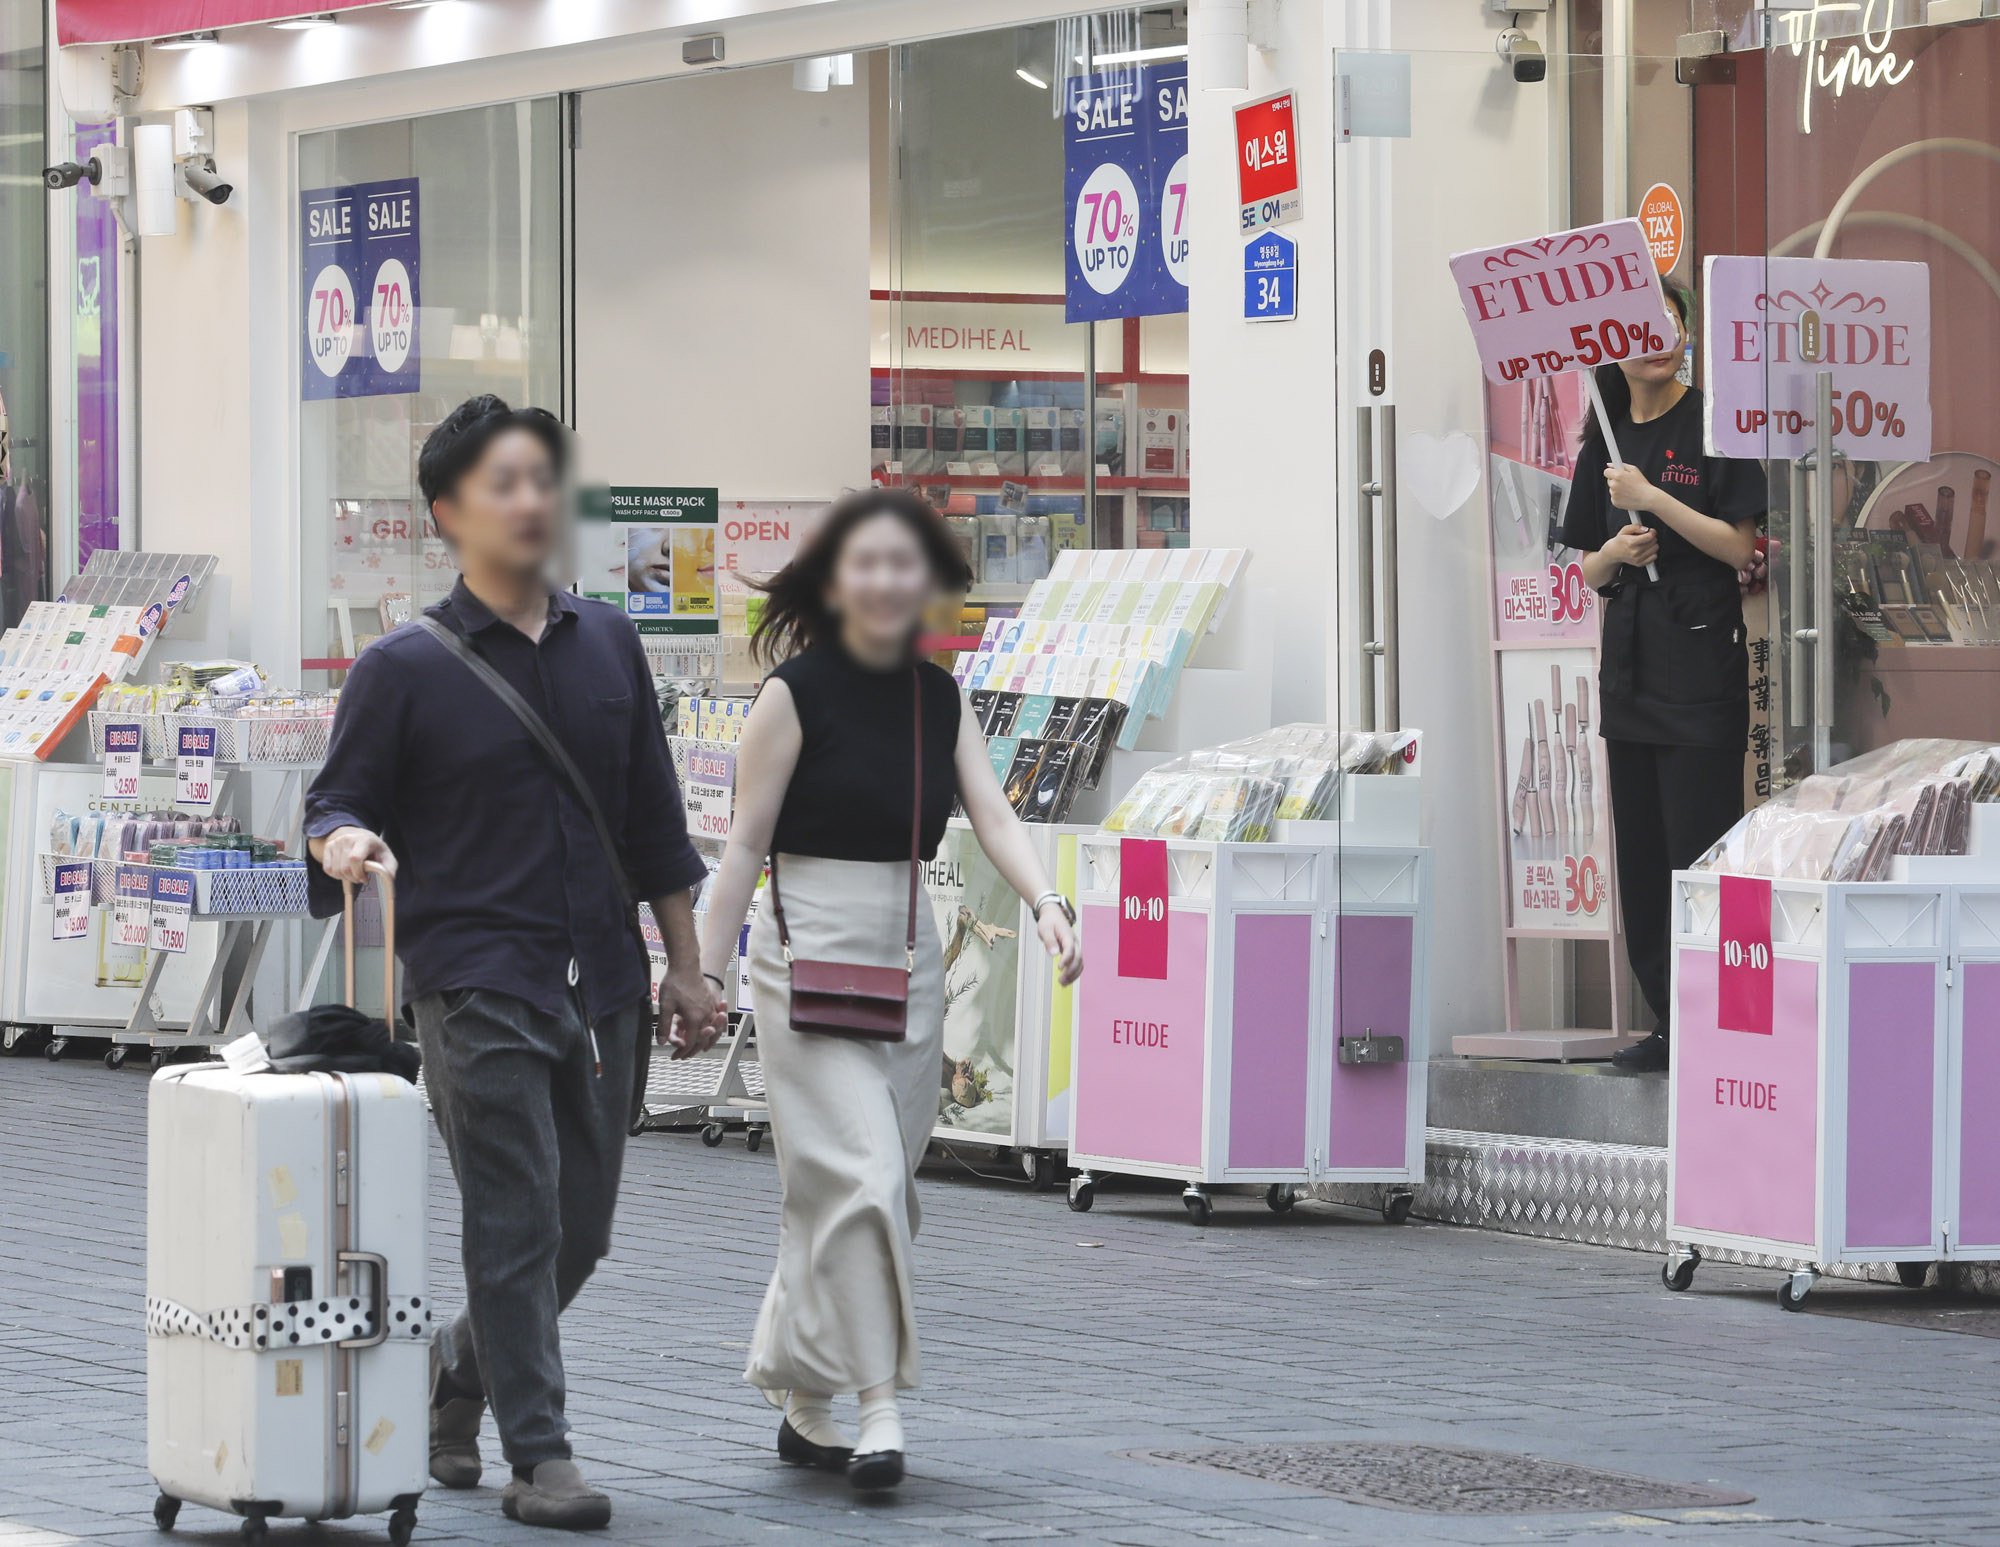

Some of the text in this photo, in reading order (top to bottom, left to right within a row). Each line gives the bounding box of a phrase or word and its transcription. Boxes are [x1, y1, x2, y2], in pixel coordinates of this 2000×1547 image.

[1076, 93, 1133, 132] SALE
[1245, 129, 1288, 171] 에스원
[368, 199, 411, 231] SALE
[1084, 190, 1134, 244] 70%
[1170, 183, 1188, 235] 7
[1242, 199, 1280, 229] SECOM
[1647, 201, 1675, 214] GLOBAL
[309, 206, 351, 238] SALE
[1646, 214, 1675, 239] TAX
[1085, 245, 1129, 272] UP TO
[1257, 276, 1280, 310] 34
[1468, 252, 1649, 322] ETUDE
[315, 287, 352, 334] 70%
[378, 282, 410, 329] 70%
[315, 336, 348, 358] UP TO
[378, 330, 407, 352] UP TO
[907, 326, 1031, 351] MEDIHEAL
[1731, 320, 1910, 366] ETUDE
[1498, 357, 1529, 381] UP
[1736, 409, 1767, 433] UP
[1661, 471, 1700, 486] ETUDE
[643, 496, 673, 507] MASK
[676, 497, 705, 507] PACK
[725, 521, 790, 541] OPEN
[424, 552, 458, 569] SA
[1511, 563, 1592, 622] 에뛰드 30%
[1504, 595, 1547, 621] 마스카라
[110, 731, 137, 745] BIG SALE
[182, 735, 209, 749] BIG SALE
[691, 757, 726, 777] BIG SALE
[118, 778, 137, 795] 2,500
[190, 782, 209, 800] 1,500
[702, 814, 729, 835] 21,900
[60, 869, 88, 886] BIG SALE
[120, 874, 148, 890] BIG SALE
[158, 877, 188, 895] BIG SALE
[1536, 865, 1555, 886] 픽스
[1564, 855, 1606, 914] 30%
[1123, 895, 1164, 922] 10+10
[1523, 889, 1560, 910] 마스카라
[69, 917, 88, 932] 15,000
[123, 924, 148, 944] 20,000
[653, 927, 664, 944] SA
[162, 929, 184, 949] 17,500
[1723, 939, 1768, 970] 10+10
[1113, 1020, 1169, 1049] ETUDE
[1715, 1077, 1777, 1111] ETUDE
